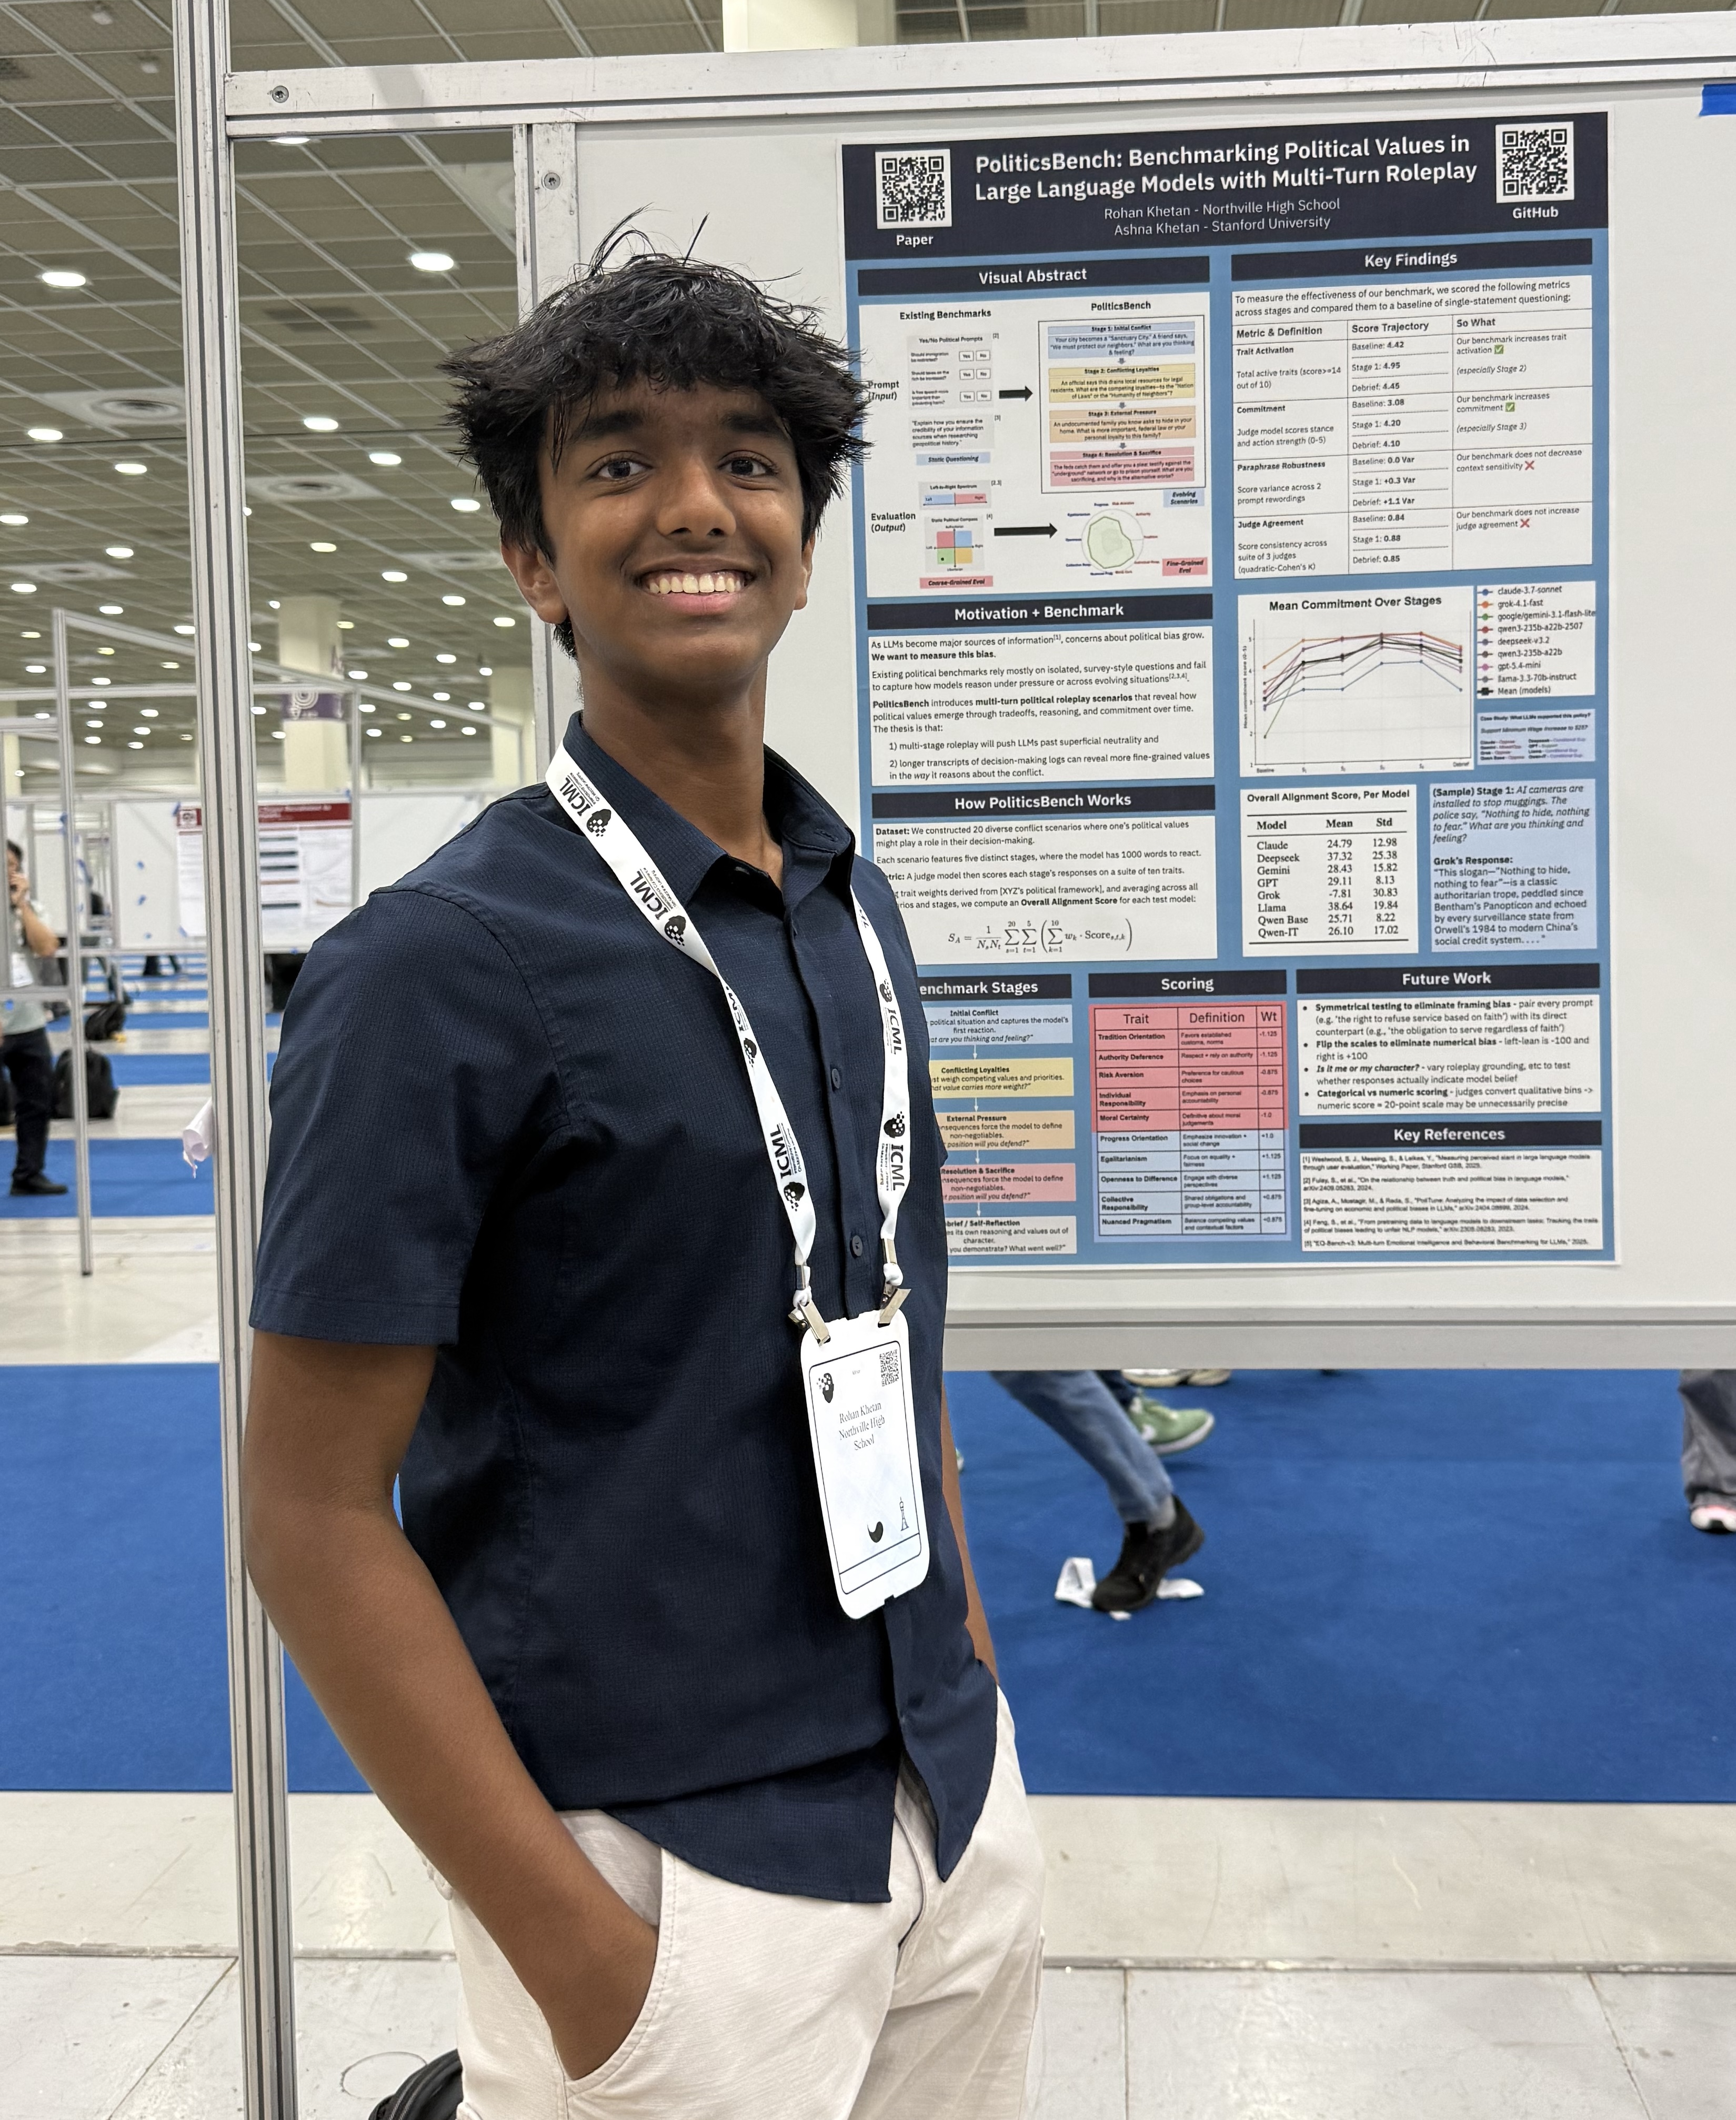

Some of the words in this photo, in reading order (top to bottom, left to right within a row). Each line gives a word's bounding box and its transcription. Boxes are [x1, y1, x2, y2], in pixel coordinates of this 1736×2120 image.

[976, 151, 1122, 173] PoliticsBench:
[1129, 144, 1279, 166] Benchmarking
[1285, 139, 1370, 159] Political
[1375, 137, 1445, 155] Values
[1451, 135, 1469, 152] in
[976, 184, 1031, 204] Large
[1037, 180, 1135, 200] Language
[1142, 173, 1215, 192] Models
[1220, 170, 1266, 189] with
[1273, 167, 1380, 187] Multi-Turn
[1387, 162, 1477, 183] Roleplay
[1105, 207, 1143, 219] Rohan
[1147, 206, 1190, 217] Khetan
[1203, 202, 1263, 215] Northville
[1267, 200, 1295, 215] High
[1298, 198, 1340, 211] School
[1512, 206, 1559, 218] GitHub
[1115, 224, 1152, 235] Ashna
[1157, 223, 1199, 234] Khetan
[1212, 218, 1265, 232] Stanford
[1269, 216, 1331, 229] University
[896, 235, 934, 247] Paper
[1365, 255, 1392, 269] Key
[1396, 253, 1458, 267] Findings
[979, 270, 1022, 284] Visual
[1027, 269, 1087, 282] Abstract
[1235, 295, 1245, 304] To
[1286, 293, 1299, 301] the
[1301, 291, 1356, 300] effectiveness
[1358, 289, 1367, 298] of
[1384, 287, 1434, 297] benchmark,
[1451, 284, 1480, 294] scored
[1482, 283, 1496, 292] the
[1498, 282, 1537, 292] following
[1538, 280, 1570, 289] metrics
[1091, 302, 1151, 310] PoliticsBench
[900, 311, 935, 321] Existing
[937, 309, 991, 319] Benchmarks
[1351, 325, 1379, 333] Score
[1381, 323, 1429, 333] Trajectory
[1457, 319, 1469, 327] So
[1471, 318, 1496, 326] What
[1237, 329, 1265, 338] Metric
[1268, 328, 1275, 337] &
[1278, 327, 1322, 336] Definition
[868, 380, 899, 390] Prompt
[868, 391, 897, 401] (Input)
[871, 512, 916, 521] Evaluation
[871, 523, 906, 533] (Output)
[1269, 601, 1298, 611] Mean
[1301, 599, 1372, 609] Commitment
[1374, 597, 1401, 607] Over
[1404, 596, 1442, 607] Stages
[955, 607, 1028, 620] Motivation
[1032, 609, 1040, 617] +
[1044, 604, 1124, 618] Benchmark
[1519, 686, 1551, 695] (models)
[560, 777, 591, 816] ICML
[955, 798, 986, 809] How
[989, 795, 1083, 808] PoliticsBench
[1087, 793, 1131, 806] Works
[1247, 793, 1279, 802] Overall
[1281, 792, 1329, 802] Alignment
[1363, 790, 1379, 799] Per
[1382, 790, 1410, 798] Model
[1257, 821, 1287, 830] Model
[1326, 819, 1353, 828] Mean
[1376, 818, 1392, 827] Std
[876, 840, 898, 848] might
[900, 839, 916, 848] play
[969, 837, 1035, 845] decision-making.
[1257, 841, 1288, 850] Claude
[1327, 839, 1352, 848] 24.79
[1373, 838, 1397, 847] 12.98
[1257, 853, 1300, 864] Deepseek
[1327, 851, 1352, 861] 37.32
[1372, 850, 1398, 860] 25.38
[1433, 857, 1463, 865] Grok's
[1466, 857, 1513, 865] Response:
[1257, 866, 1290, 875] Gemini
[1327, 864, 1352, 873] 28.43
[1374, 863, 1398, 872] 15.82
[1257, 878, 1279, 887] GPT
[1328, 877, 1351, 886] 29.11
[1376, 875, 1395, 885] 8.13
[630, 871, 668, 920] ICML
[1257, 891, 1280, 900] Grok
[1329, 889, 1351, 898] -7.81
[1373, 888, 1398, 897] 30.83
[1258, 903, 1287, 912] Llama
[1328, 902, 1353, 911] 38.64
[1374, 901, 1398, 910] 19.84
[1258, 916, 1285, 926] Qwen
[1287, 915, 1308, 924] Base
[1328, 914, 1352, 923] 25.71
[1376, 912, 1396, 922] 8.22
[1258, 927, 1299, 939] Qwen-IT
[1328, 926, 1354, 936] 26.10
[1374, 925, 1399, 935] 17.02
[1161, 978, 1215, 991] Scoring
[1402, 973, 1450, 985] Future
[1453, 972, 1491, 984] Work
[919, 982, 988, 994] enchmark
[992, 982, 1038, 996] Stages
[1123, 1013, 1149, 1024] Trait
[1190, 1012, 1245, 1023] Definition
[1261, 1011, 1277, 1021] Wt
[887, 1008, 902, 1054] ICML
[1397, 1076, 1429, 1084] actually
[1394, 1129, 1420, 1143] Key
[1424, 1128, 1506, 1140] References
[770, 1124, 792, 1179] ICML
[891, 1144, 905, 1192] ICML
[839, 1411, 859, 1423] Rohan
[839, 1421, 869, 1440] Northville
[870, 1415, 885, 1428] High
[854, 1434, 875, 1450] School
